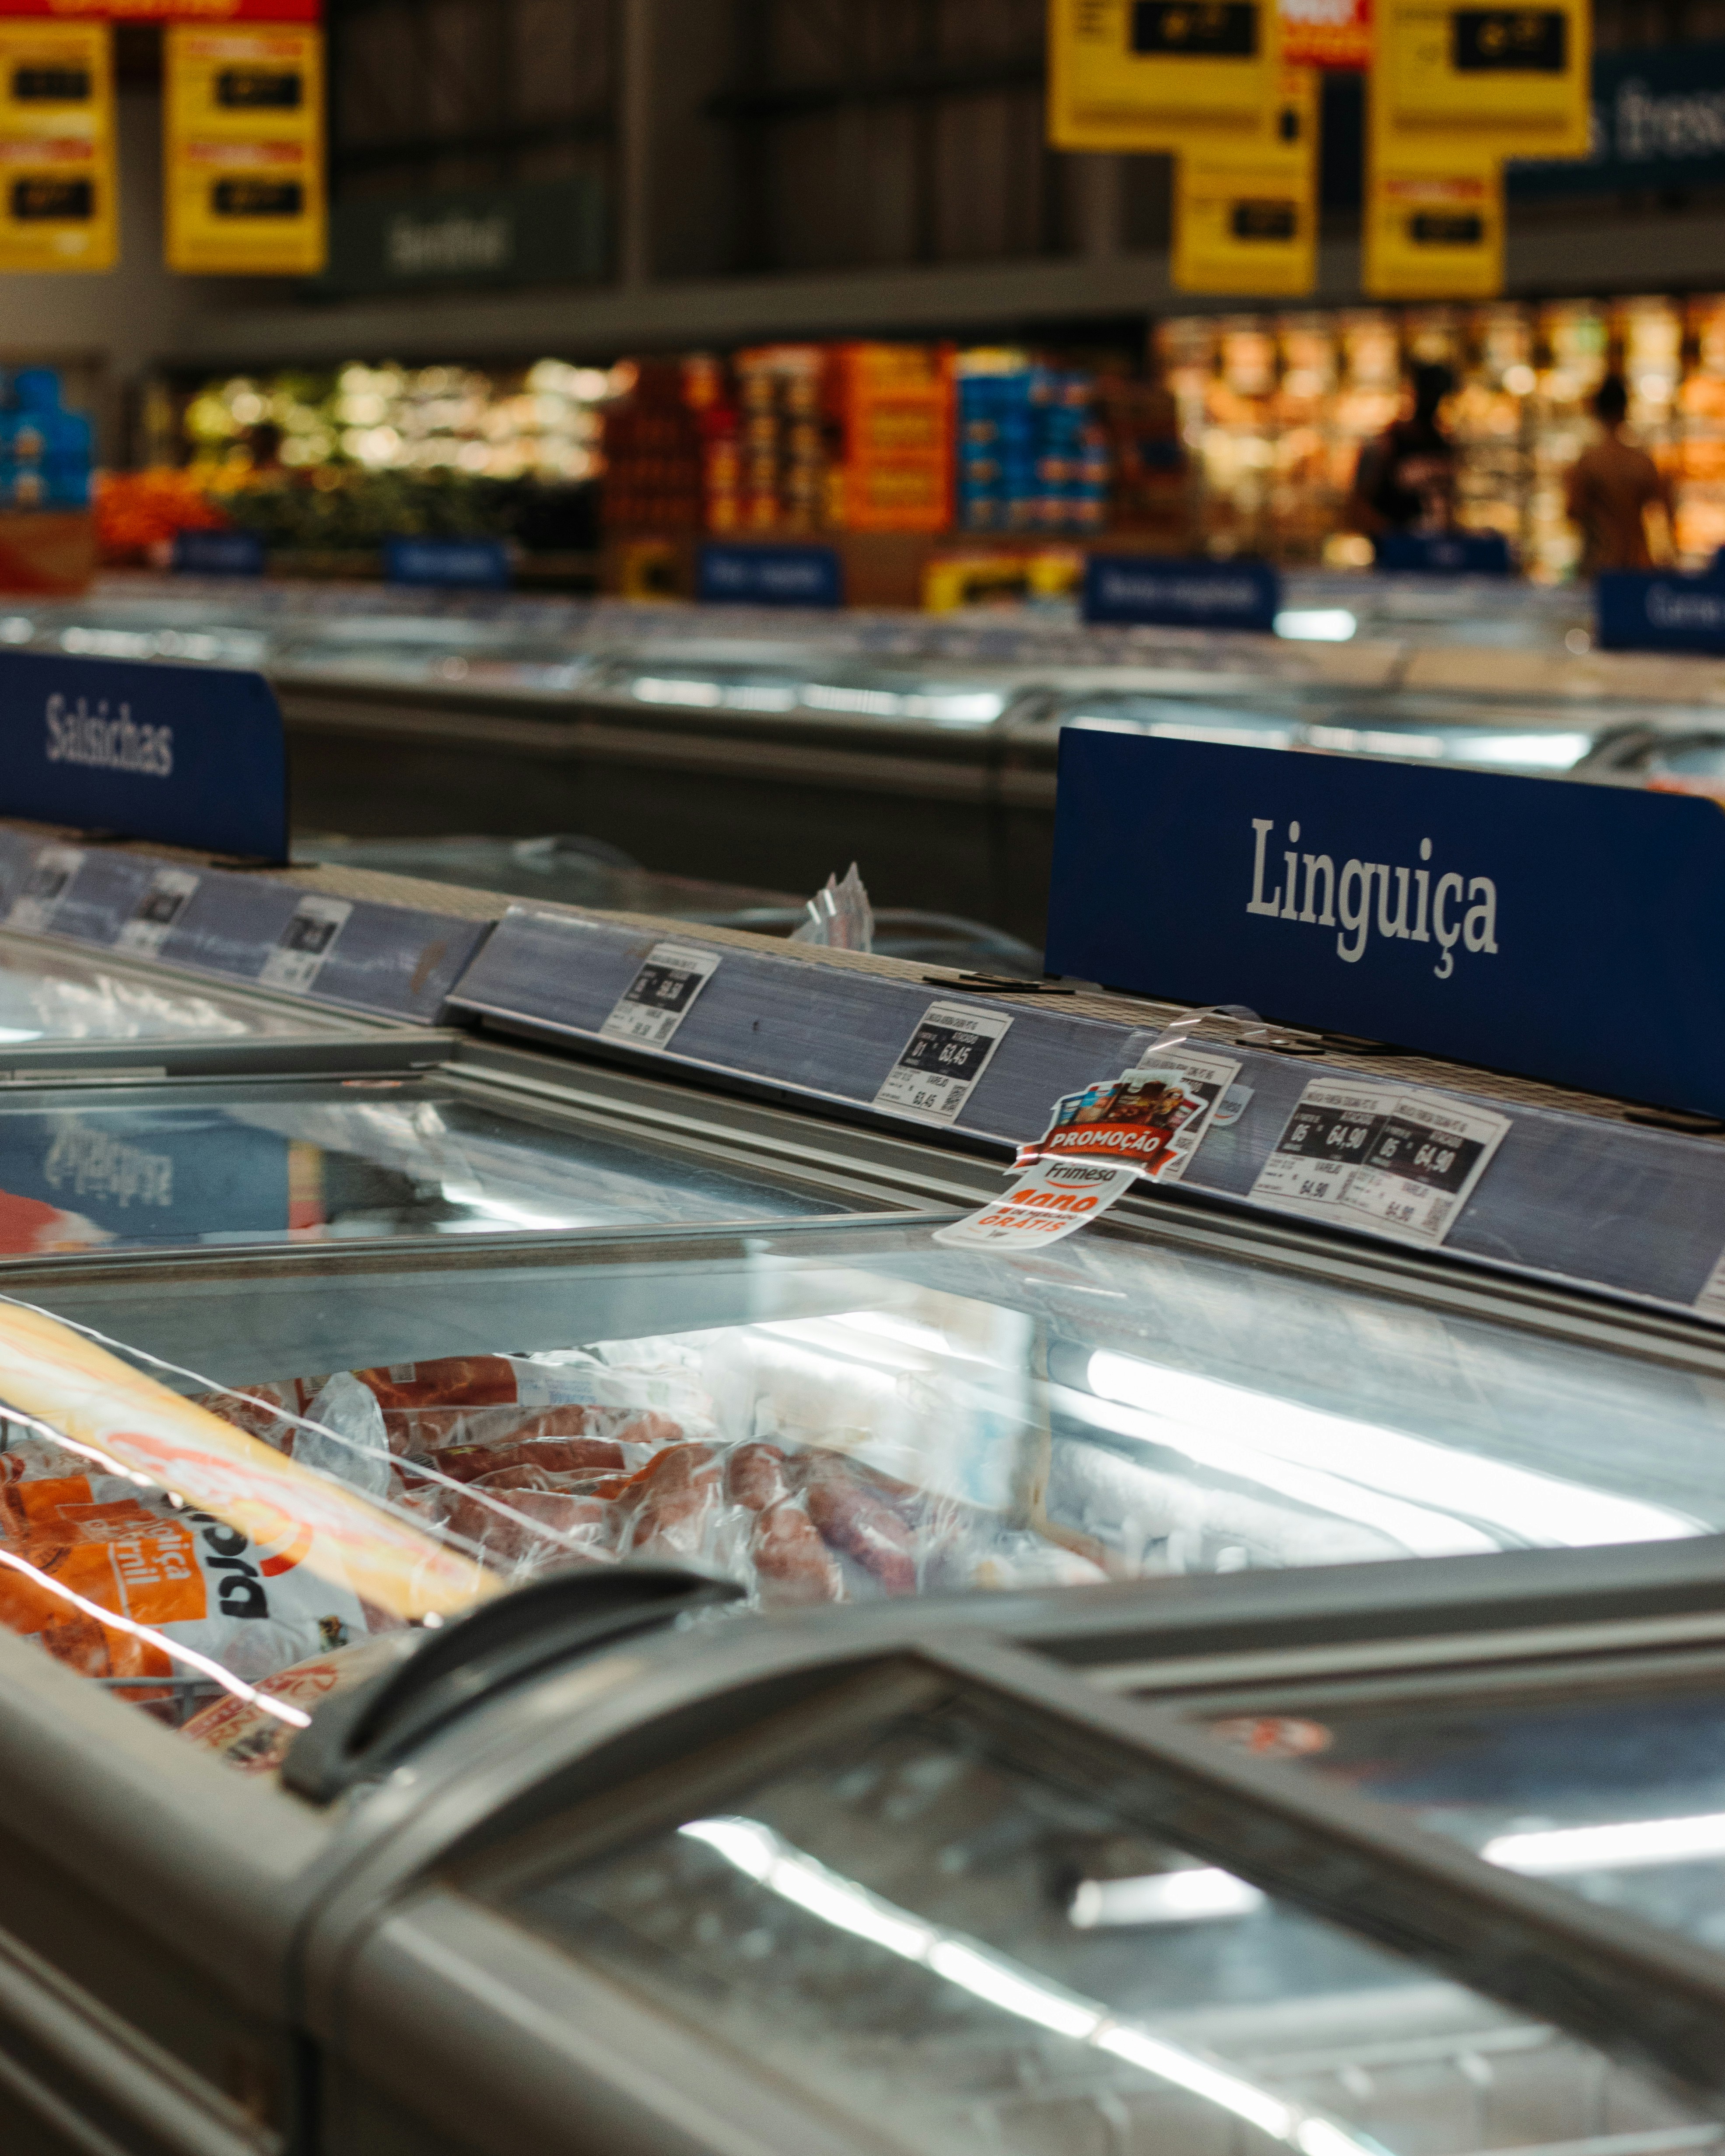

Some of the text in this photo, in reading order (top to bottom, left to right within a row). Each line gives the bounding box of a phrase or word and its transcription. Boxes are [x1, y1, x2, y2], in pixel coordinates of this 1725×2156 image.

[45, 692, 173, 778] Salsichas
[1246, 818, 1498, 979] Linguiça
[938, 1042, 972, 1066] 63,45
[1050, 1130, 1161, 1153] PROMOÇÃO
[1325, 1125, 1369, 1150] 64,90
[1413, 1143, 1456, 1174] 64,90
[1044, 1162, 1117, 1181] Frimesa
